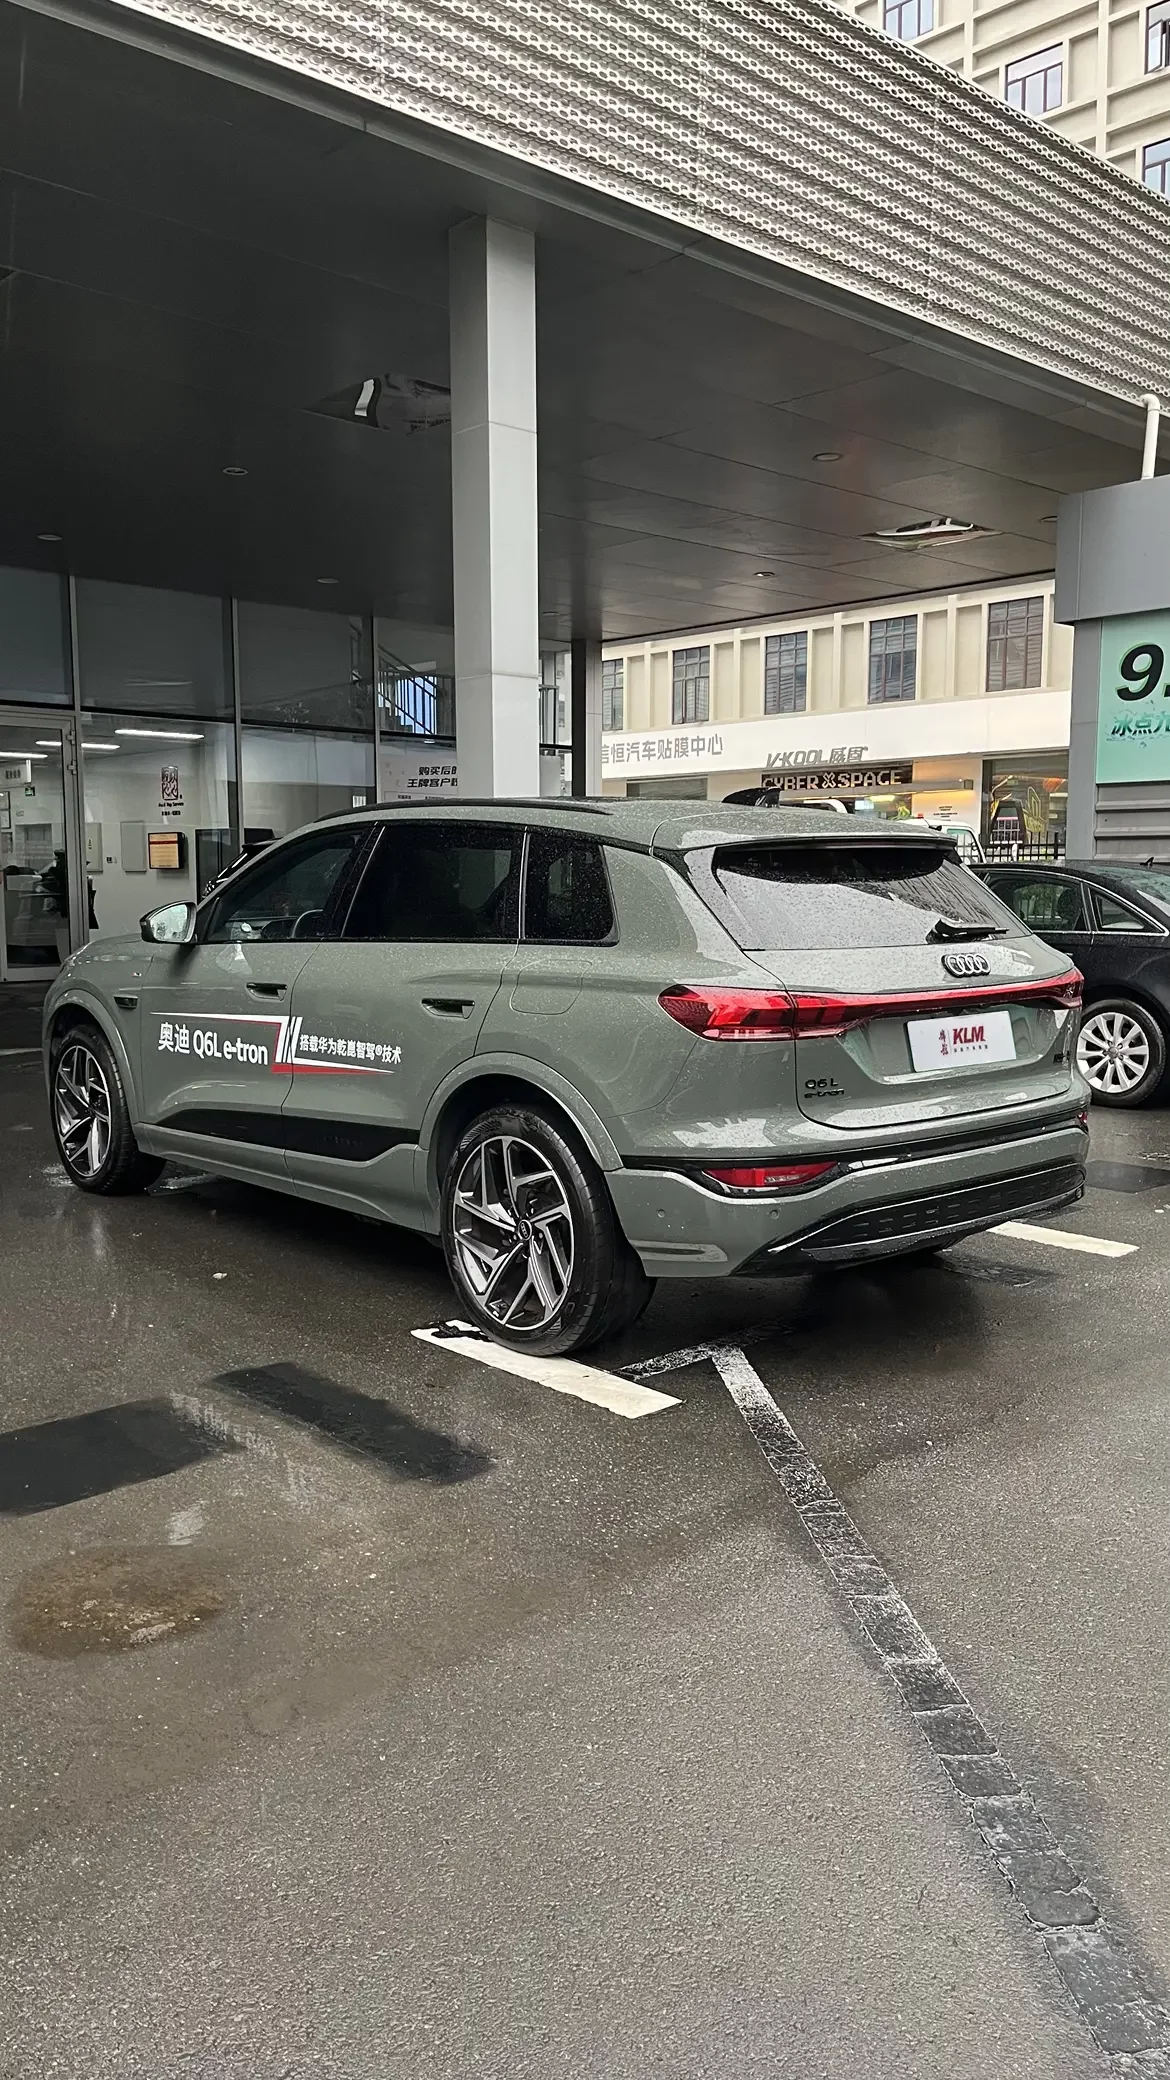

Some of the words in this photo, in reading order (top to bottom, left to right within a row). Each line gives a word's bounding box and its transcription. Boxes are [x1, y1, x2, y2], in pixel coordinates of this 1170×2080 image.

[766, 749, 828, 768] V-KOOL
[762, 774, 819, 791] CYBER
[837, 769, 902, 788] SPACE
[158, 1022, 190, 1054] 奥迪
[193, 1030, 222, 1059] Q6L
[223, 1037, 268, 1065] e-tron
[952, 1025, 986, 1045] KLM
